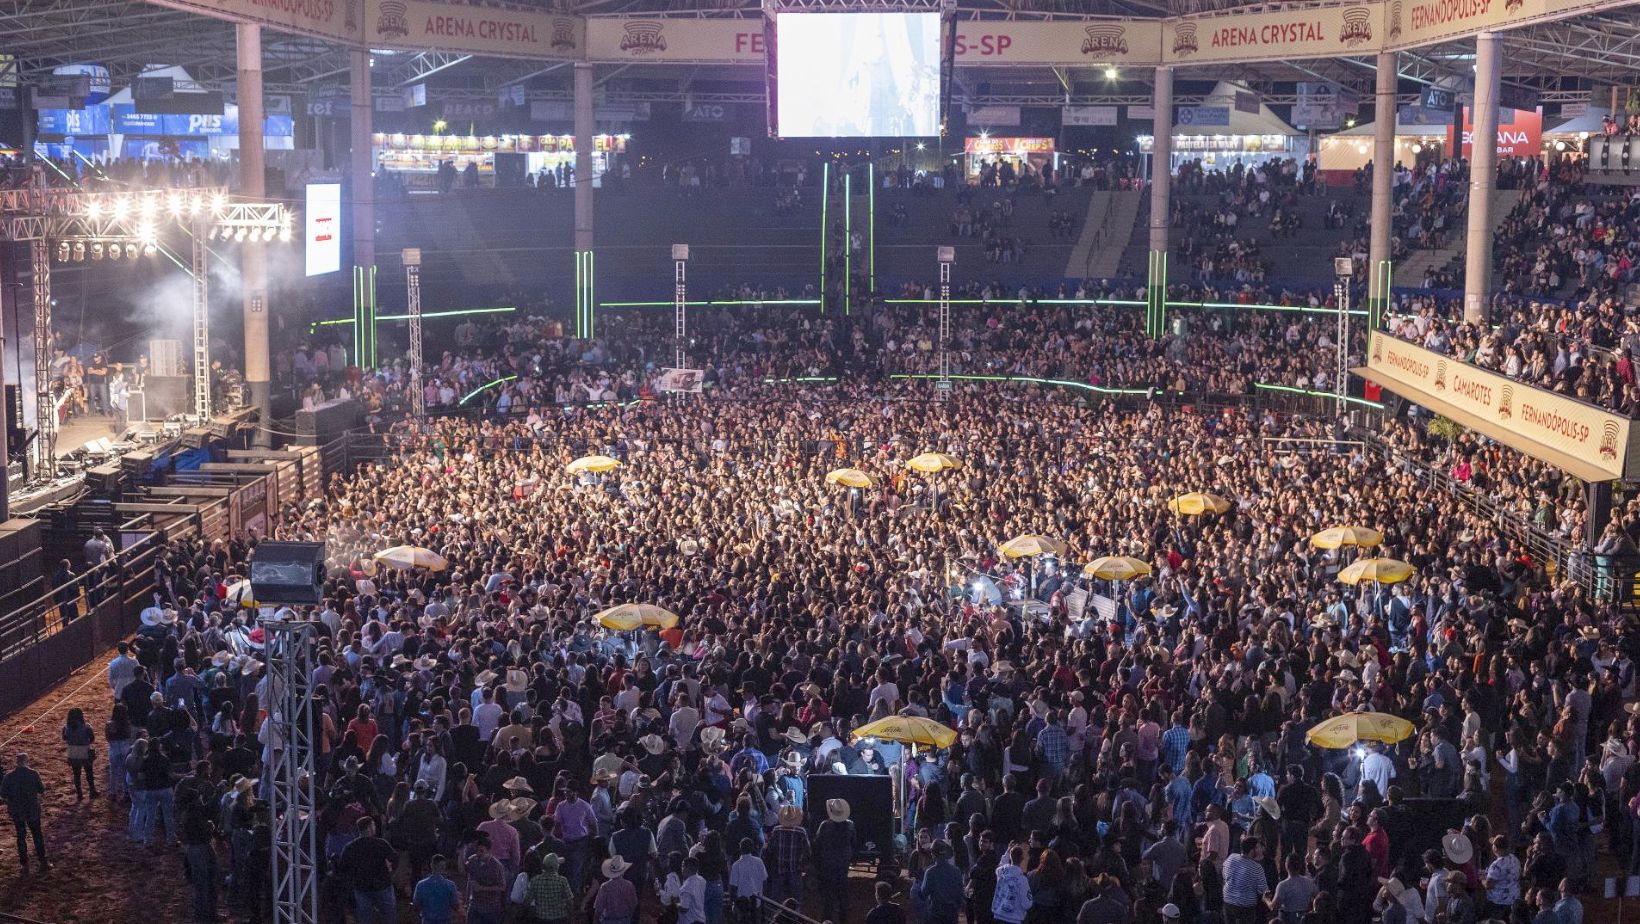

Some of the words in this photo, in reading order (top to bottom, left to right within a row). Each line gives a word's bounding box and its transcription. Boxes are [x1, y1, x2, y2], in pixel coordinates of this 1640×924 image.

[425, 16, 475, 38] ARENA
[479, 20, 538, 42] CRYSTAL
[620, 33, 668, 51] ARENA
[1212, 28, 1257, 47] ARENA
[1261, 21, 1324, 44] CRYSTAL
[1081, 36, 1129, 55] ARENA
[1453, 374, 1492, 406] CAMAROTES
[1522, 403, 1589, 443] FERNANDÓPOLIS-SP
